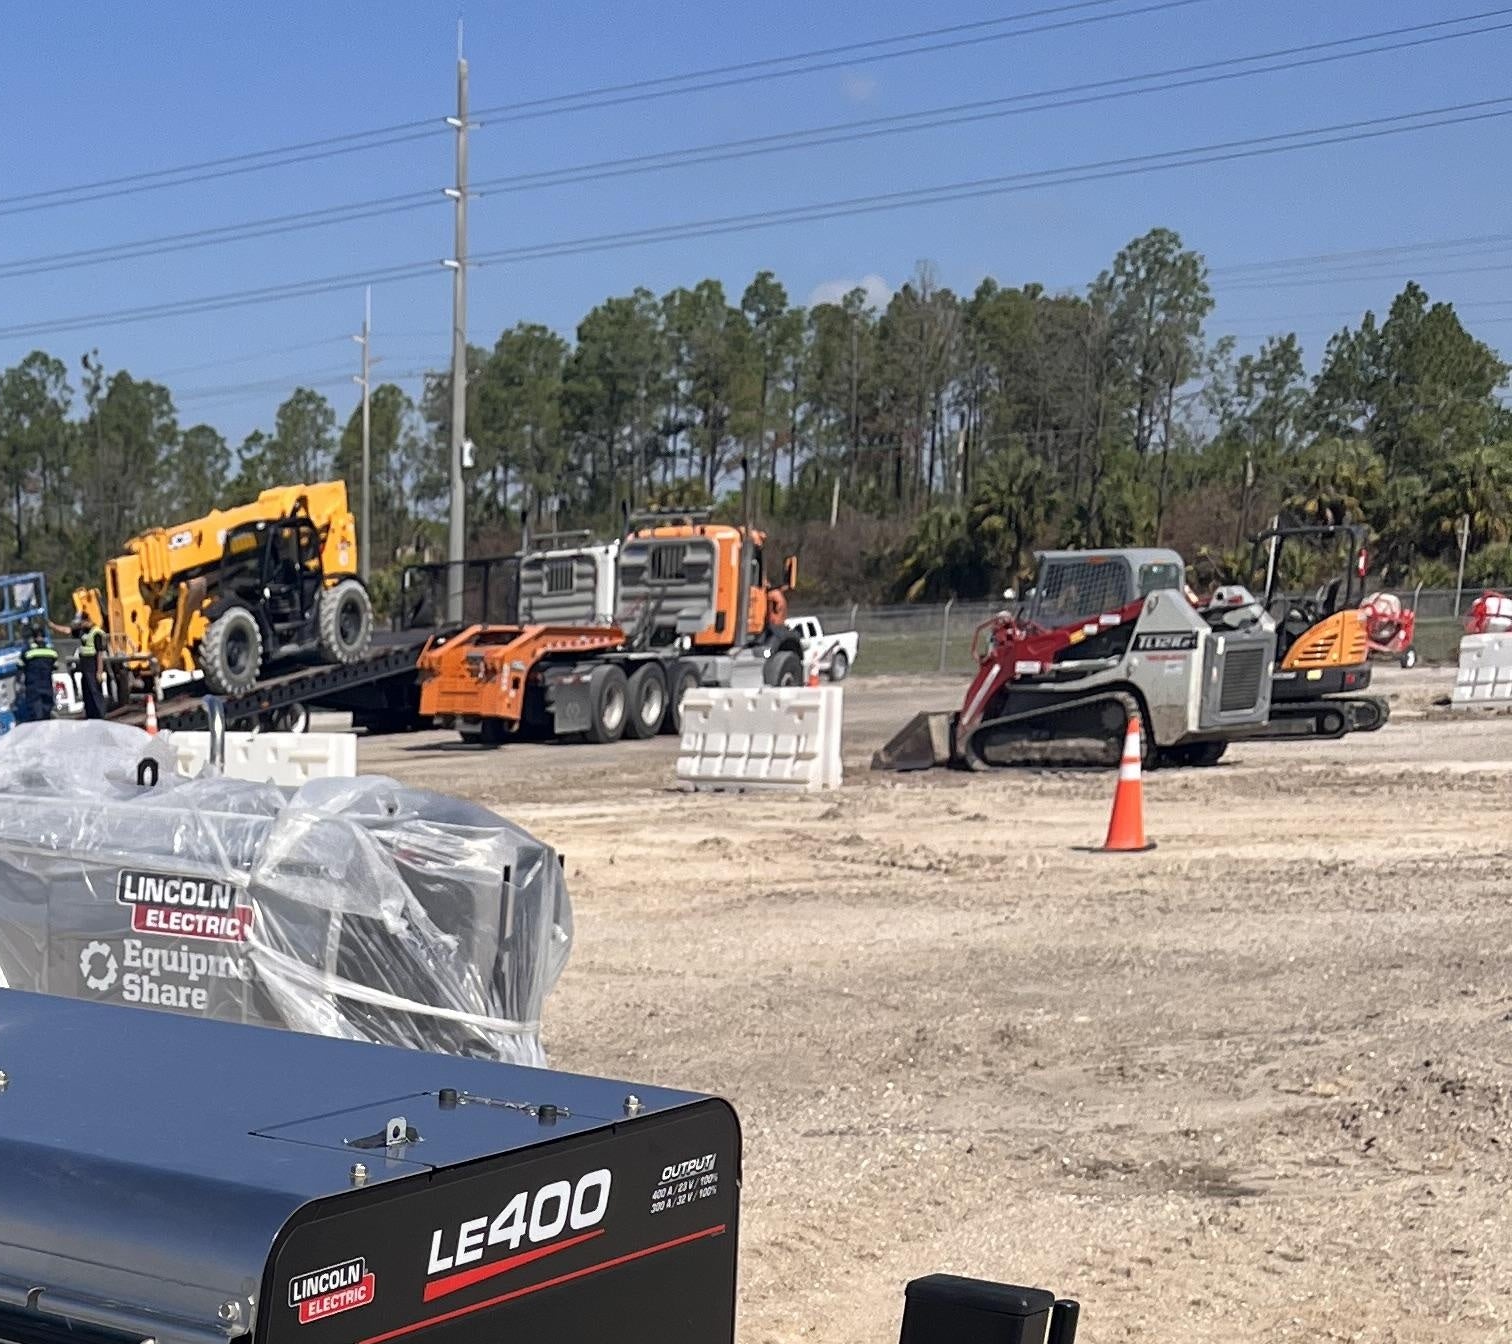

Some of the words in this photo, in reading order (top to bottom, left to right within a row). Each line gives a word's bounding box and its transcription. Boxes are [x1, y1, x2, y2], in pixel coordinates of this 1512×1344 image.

[124, 875, 231, 909] LINCOLN
[146, 909, 240, 936] ELECTRIC
[122, 973, 208, 1010] Share
[661, 1154, 713, 1181] OUTPUT
[427, 1168, 612, 1276] LE400
[293, 1263, 360, 1301] LINCOLN
[308, 1285, 367, 1317] ELECTRIC
